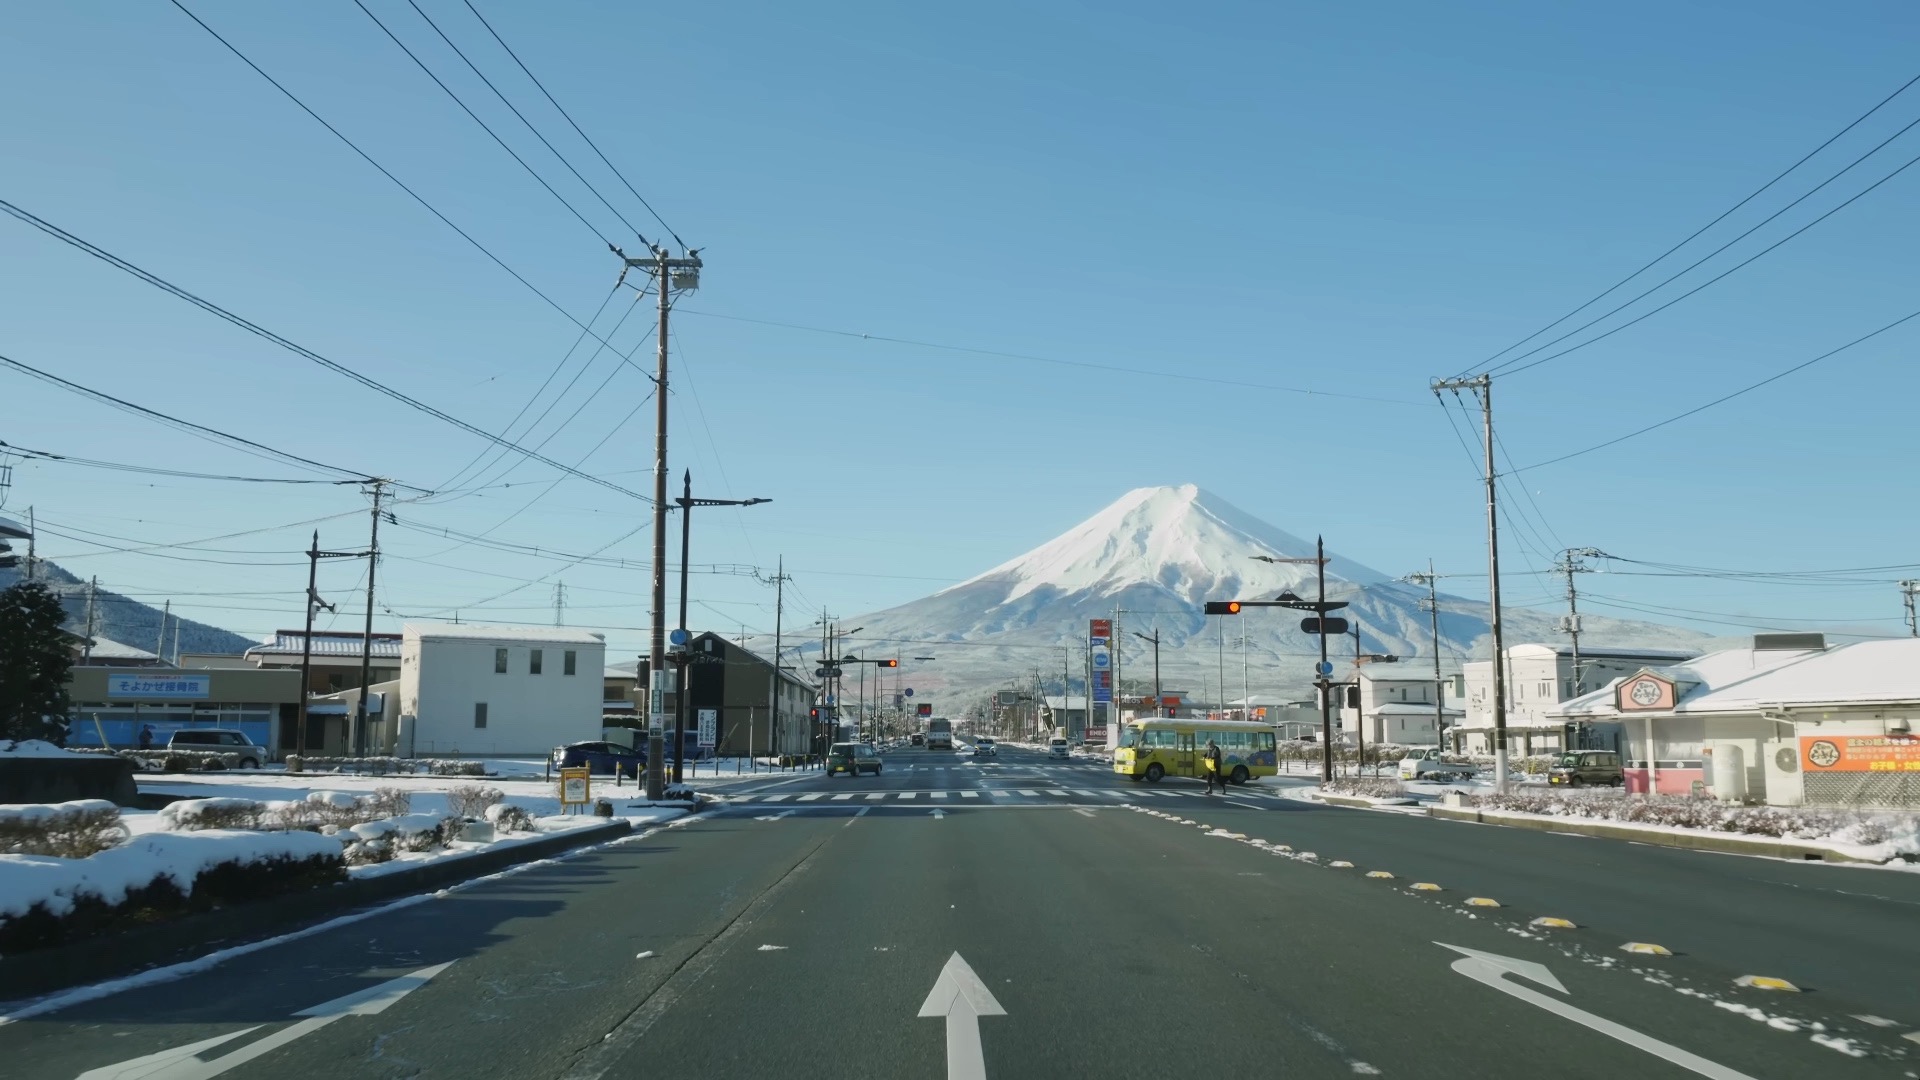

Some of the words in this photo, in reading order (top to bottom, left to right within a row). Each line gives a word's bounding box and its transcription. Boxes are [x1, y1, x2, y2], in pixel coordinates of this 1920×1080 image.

[119, 681, 199, 692] そよかぜ接骨院
